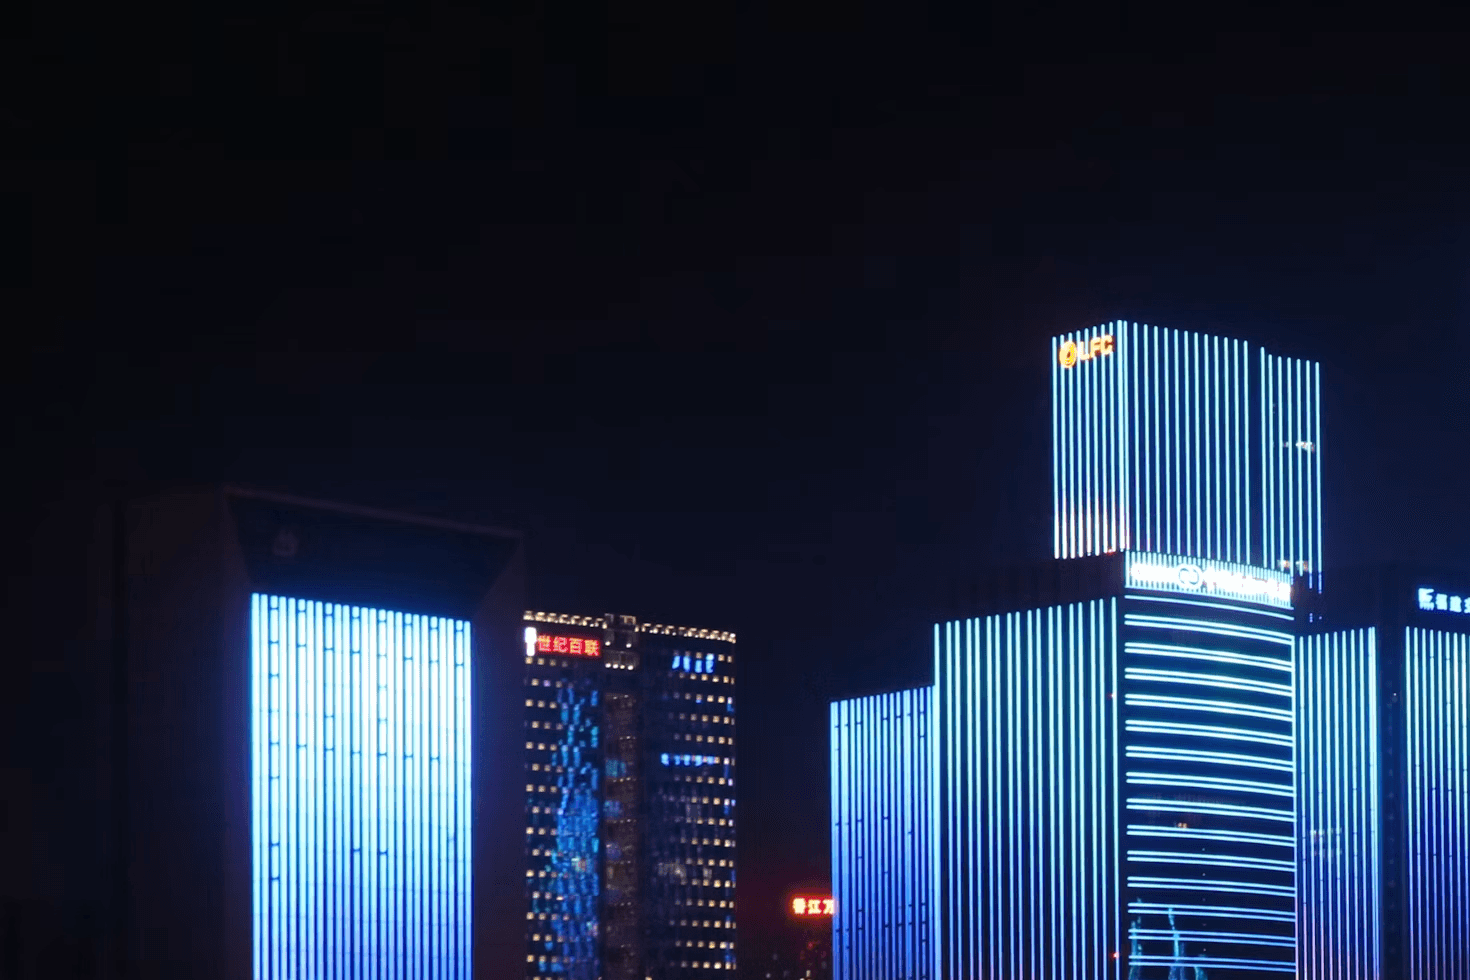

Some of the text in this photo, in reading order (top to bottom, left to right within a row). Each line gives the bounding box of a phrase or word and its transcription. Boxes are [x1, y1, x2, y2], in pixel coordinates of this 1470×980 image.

[1079, 335, 1111, 360] LFC
[538, 635, 599, 656] 世纪百联
